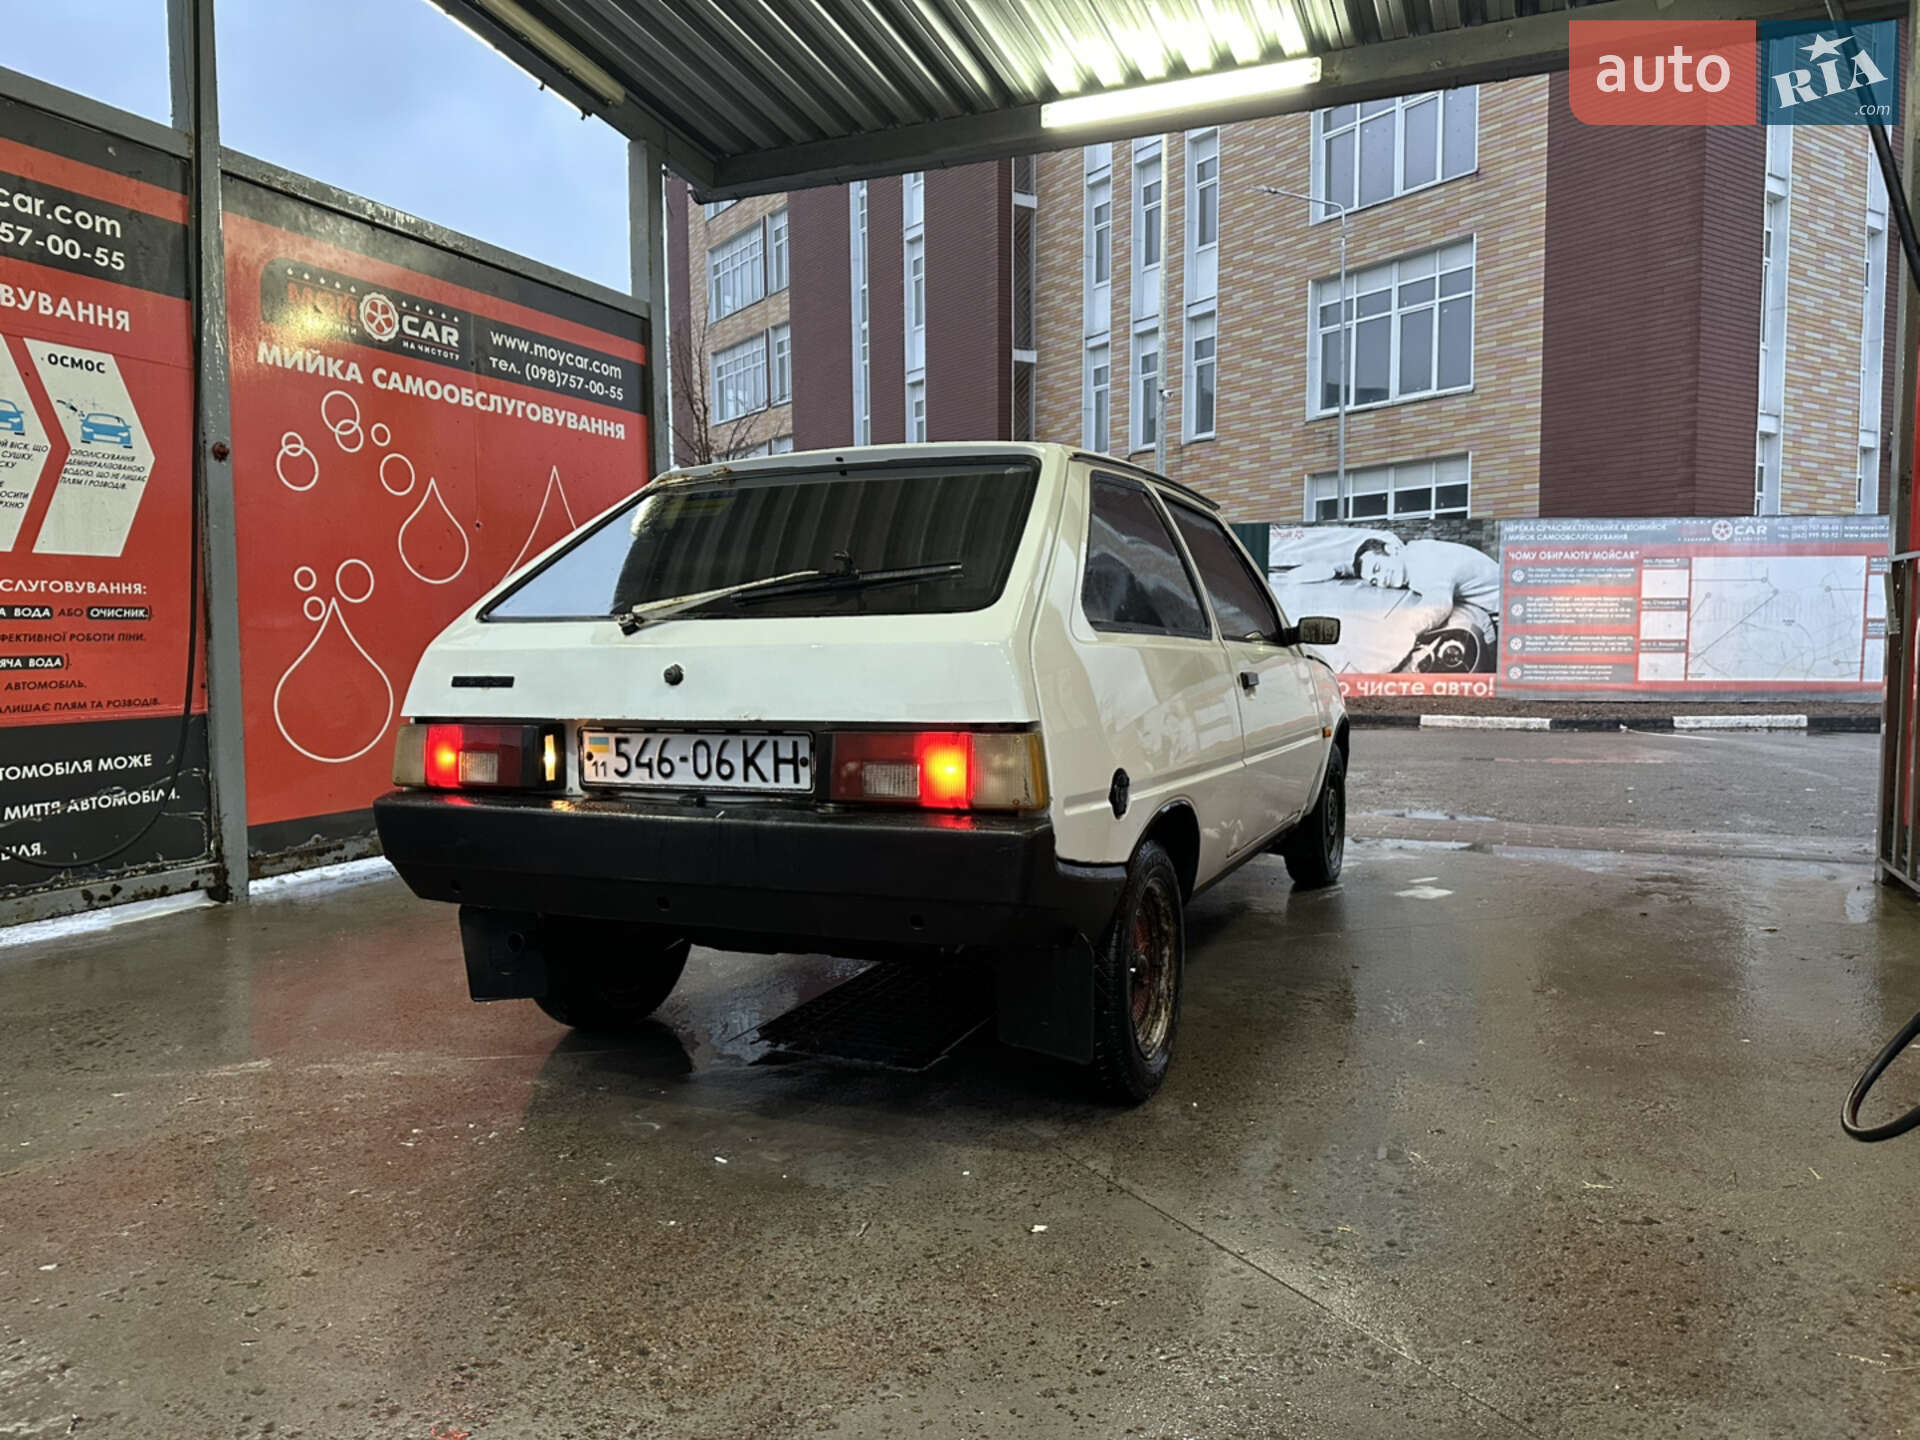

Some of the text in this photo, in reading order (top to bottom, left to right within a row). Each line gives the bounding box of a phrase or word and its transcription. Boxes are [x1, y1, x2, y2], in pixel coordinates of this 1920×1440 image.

[0, 282, 131, 332] ВУВАННЯ
[402, 314, 460, 348] CAR
[47, 353, 106, 374] ОСМОС
[489, 331, 623, 380] www.moycar.com
[489, 356, 625, 401] тел. (098)757-00-55
[257, 341, 626, 441] МИЙКА САМООБСЛУГОВУВАННЯ
[1734, 525, 1768, 536] CAR
[0, 578, 148, 595] СЛУГОВУВАННЯ:
[14, 607, 52, 619] ВОДА
[58, 608, 84, 618] АБО
[69, 631, 115, 643] РОБОТИ
[4, 679, 88, 692] АВТОМОБІЛЬ.
[1356, 681, 1426, 697] чисте
[1432, 675, 1495, 697] авто!
[54, 701, 88, 712] ПЛЯМ
[90, 700, 104, 709] ТА
[97, 753, 153, 772] МОЖЕ
[591, 761, 608, 778] 11
[4, 800, 62, 821] МИТТЯ
